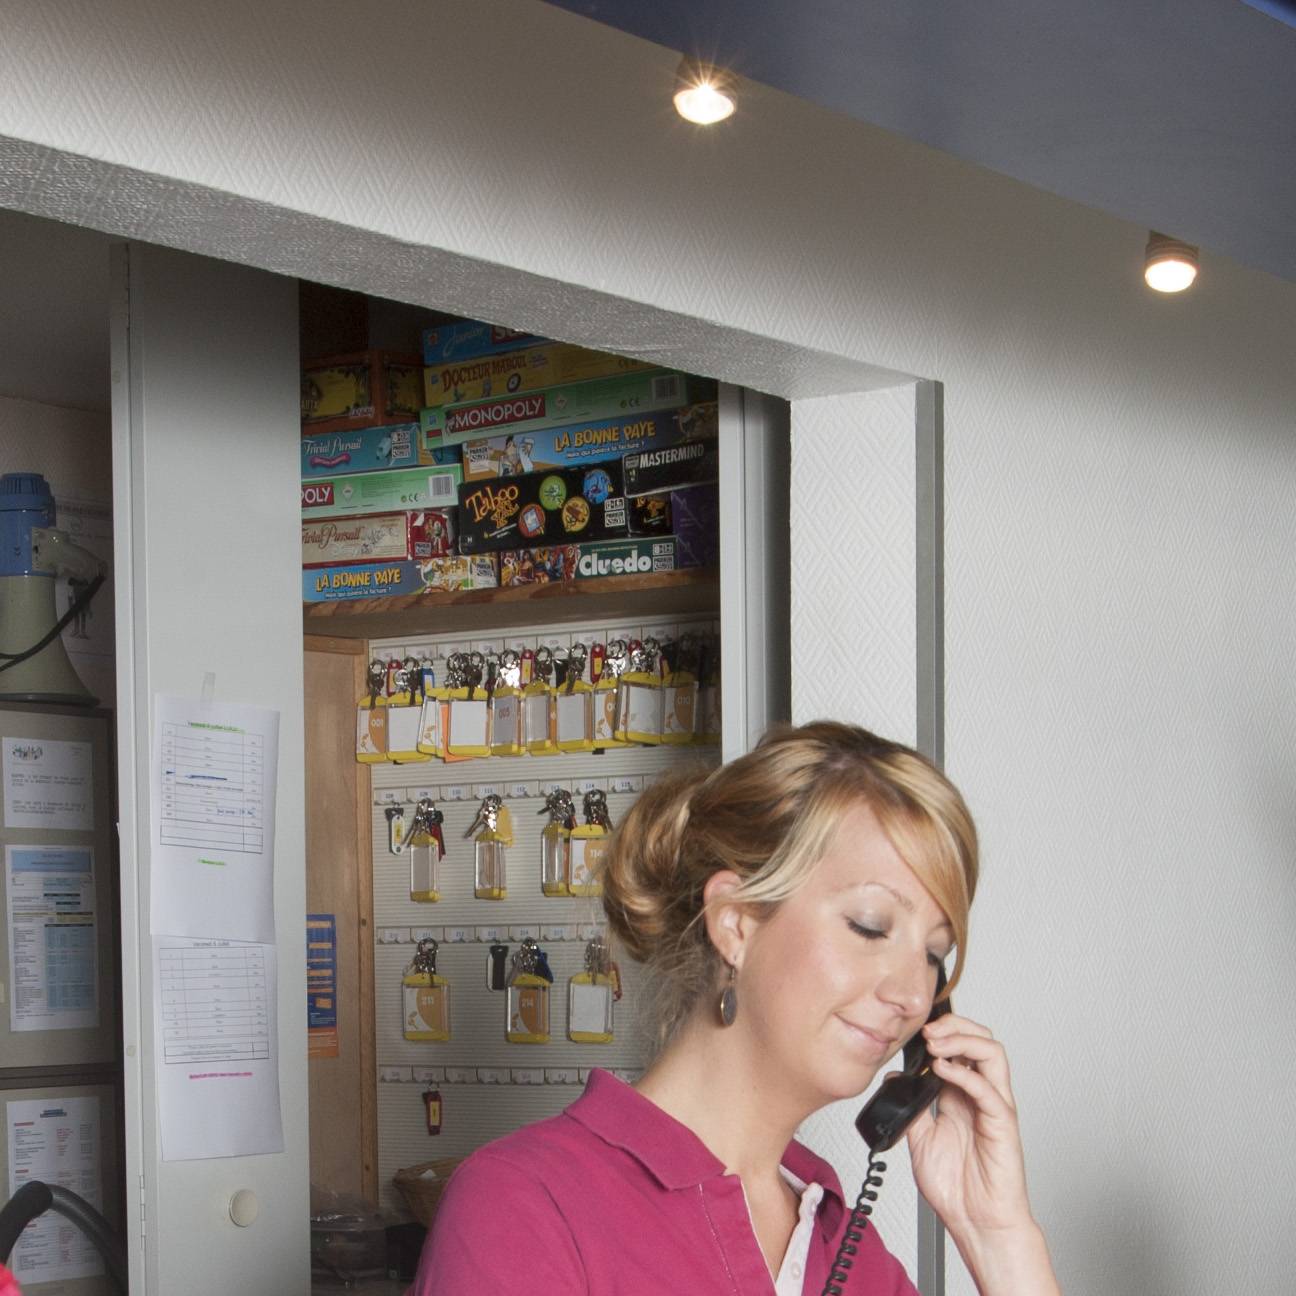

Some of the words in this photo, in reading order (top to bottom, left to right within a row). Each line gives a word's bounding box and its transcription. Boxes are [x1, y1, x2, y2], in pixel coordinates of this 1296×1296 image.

[442, 359, 491, 393] DOCTEUR
[492, 355, 527, 375] MABOUL
[455, 398, 542, 428] MONOPOLY
[302, 438, 330, 456] Trivial
[330, 436, 363, 458] Pursuit
[555, 431, 571, 452] LA
[574, 425, 620, 448] BONNE
[623, 421, 656, 442] PAYE
[639, 444, 704, 469] MASTERMIND
[465, 484, 519, 523] Taboo
[319, 523, 364, 549] Pursuit
[579, 549, 652, 576] Cluedo
[316, 573, 329, 592] LA
[332, 570, 371, 588] BONNE
[374, 568, 402, 585] PAYE
